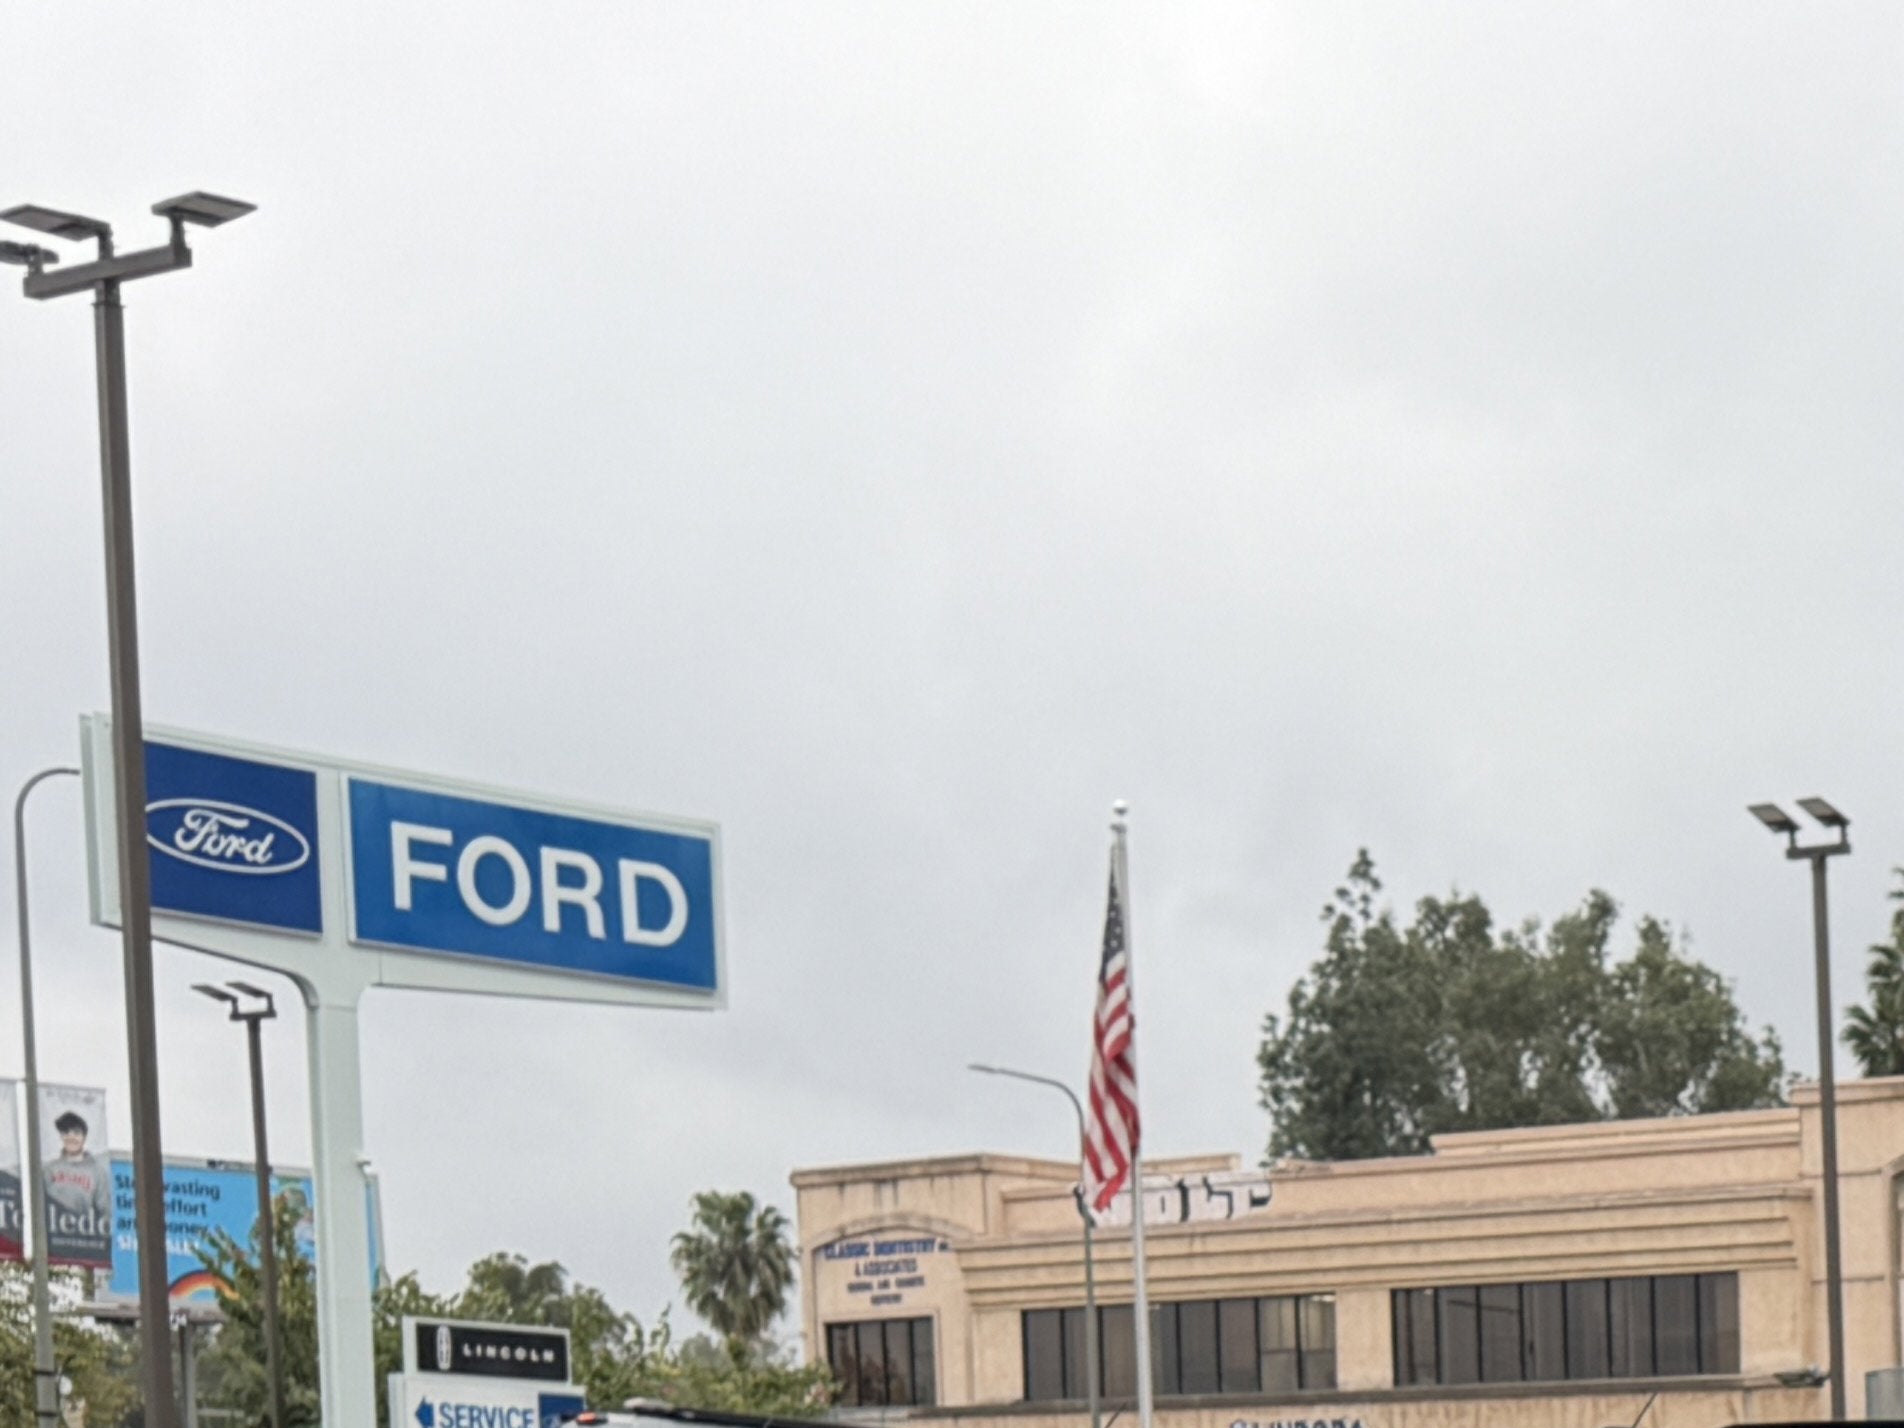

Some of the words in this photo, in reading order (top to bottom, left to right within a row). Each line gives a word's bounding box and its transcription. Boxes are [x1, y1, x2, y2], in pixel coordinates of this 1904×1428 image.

[174, 808, 275, 864] Ford
[390, 820, 688, 947] FORD
[462, 1342, 556, 1363] LINCOLN
